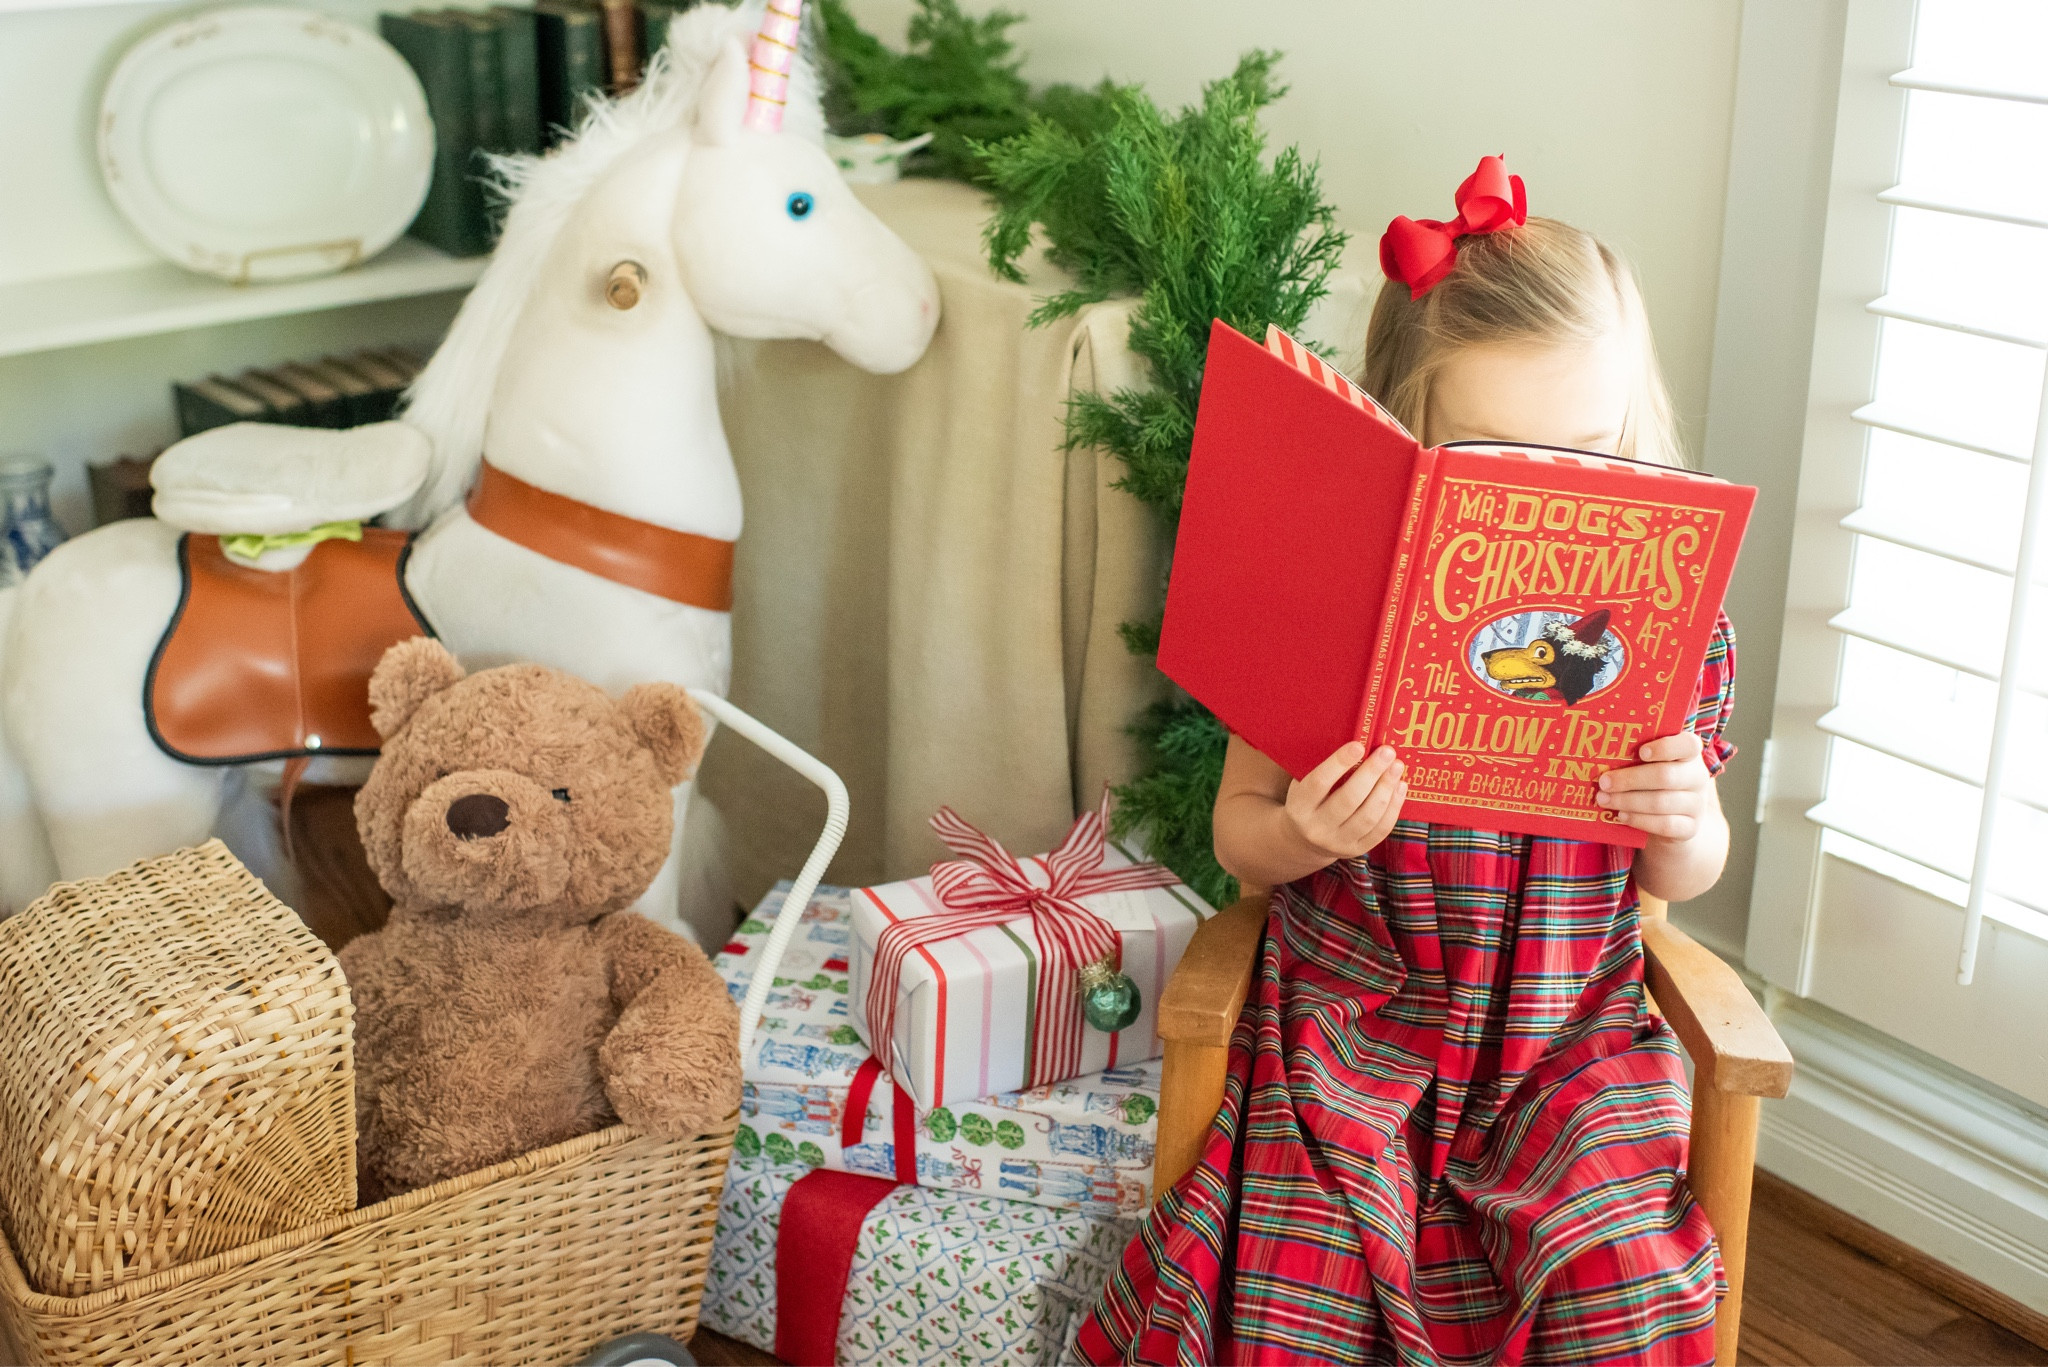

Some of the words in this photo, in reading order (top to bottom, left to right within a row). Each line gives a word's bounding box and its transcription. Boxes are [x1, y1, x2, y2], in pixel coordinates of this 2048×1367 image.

[1498, 492, 1653, 540] DOG'S
[1391, 573, 1405, 603] DOG'S
[1433, 525, 1700, 622] CHRISTMAS
[1378, 604, 1398, 660] CHRISTMAS
[1636, 611, 1672, 660] AT
[1371, 673, 1382, 693] THE
[1375, 660, 1385, 673] AT
[1424, 660, 1461, 698] THE
[1362, 694, 1377, 734] HOLLOW
[1393, 700, 1557, 756] HOLLOW
[1556, 709, 1643, 761] TREE
[1400, 764, 1465, 791] LBERT
[1469, 773, 1558, 803] BIGELOW
[1481, 798, 1496, 809] BY
[1499, 801, 1531, 813] ADAM
